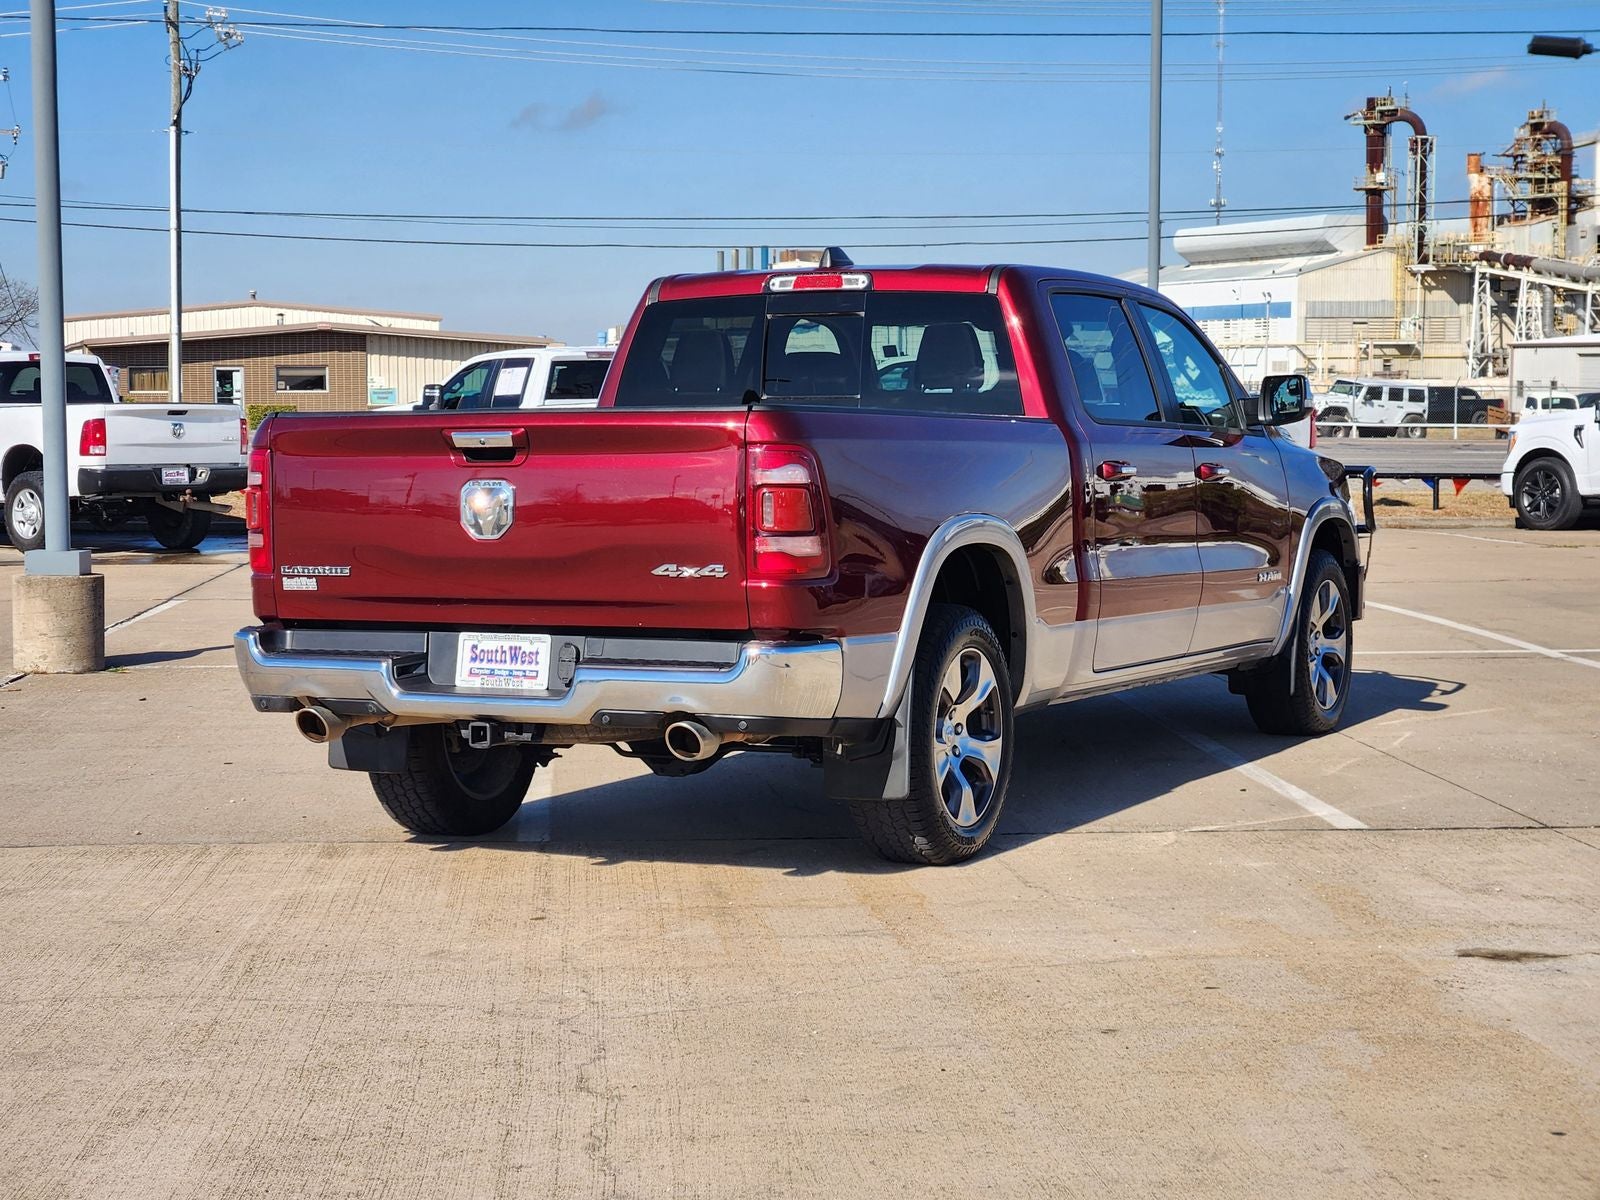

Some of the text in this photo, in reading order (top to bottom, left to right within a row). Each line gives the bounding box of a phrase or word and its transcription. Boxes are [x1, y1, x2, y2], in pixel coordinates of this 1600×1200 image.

[281, 566, 350, 576] LARAMIE
[650, 563, 728, 578] 4x4
[469, 644, 540, 666] SouthWest
